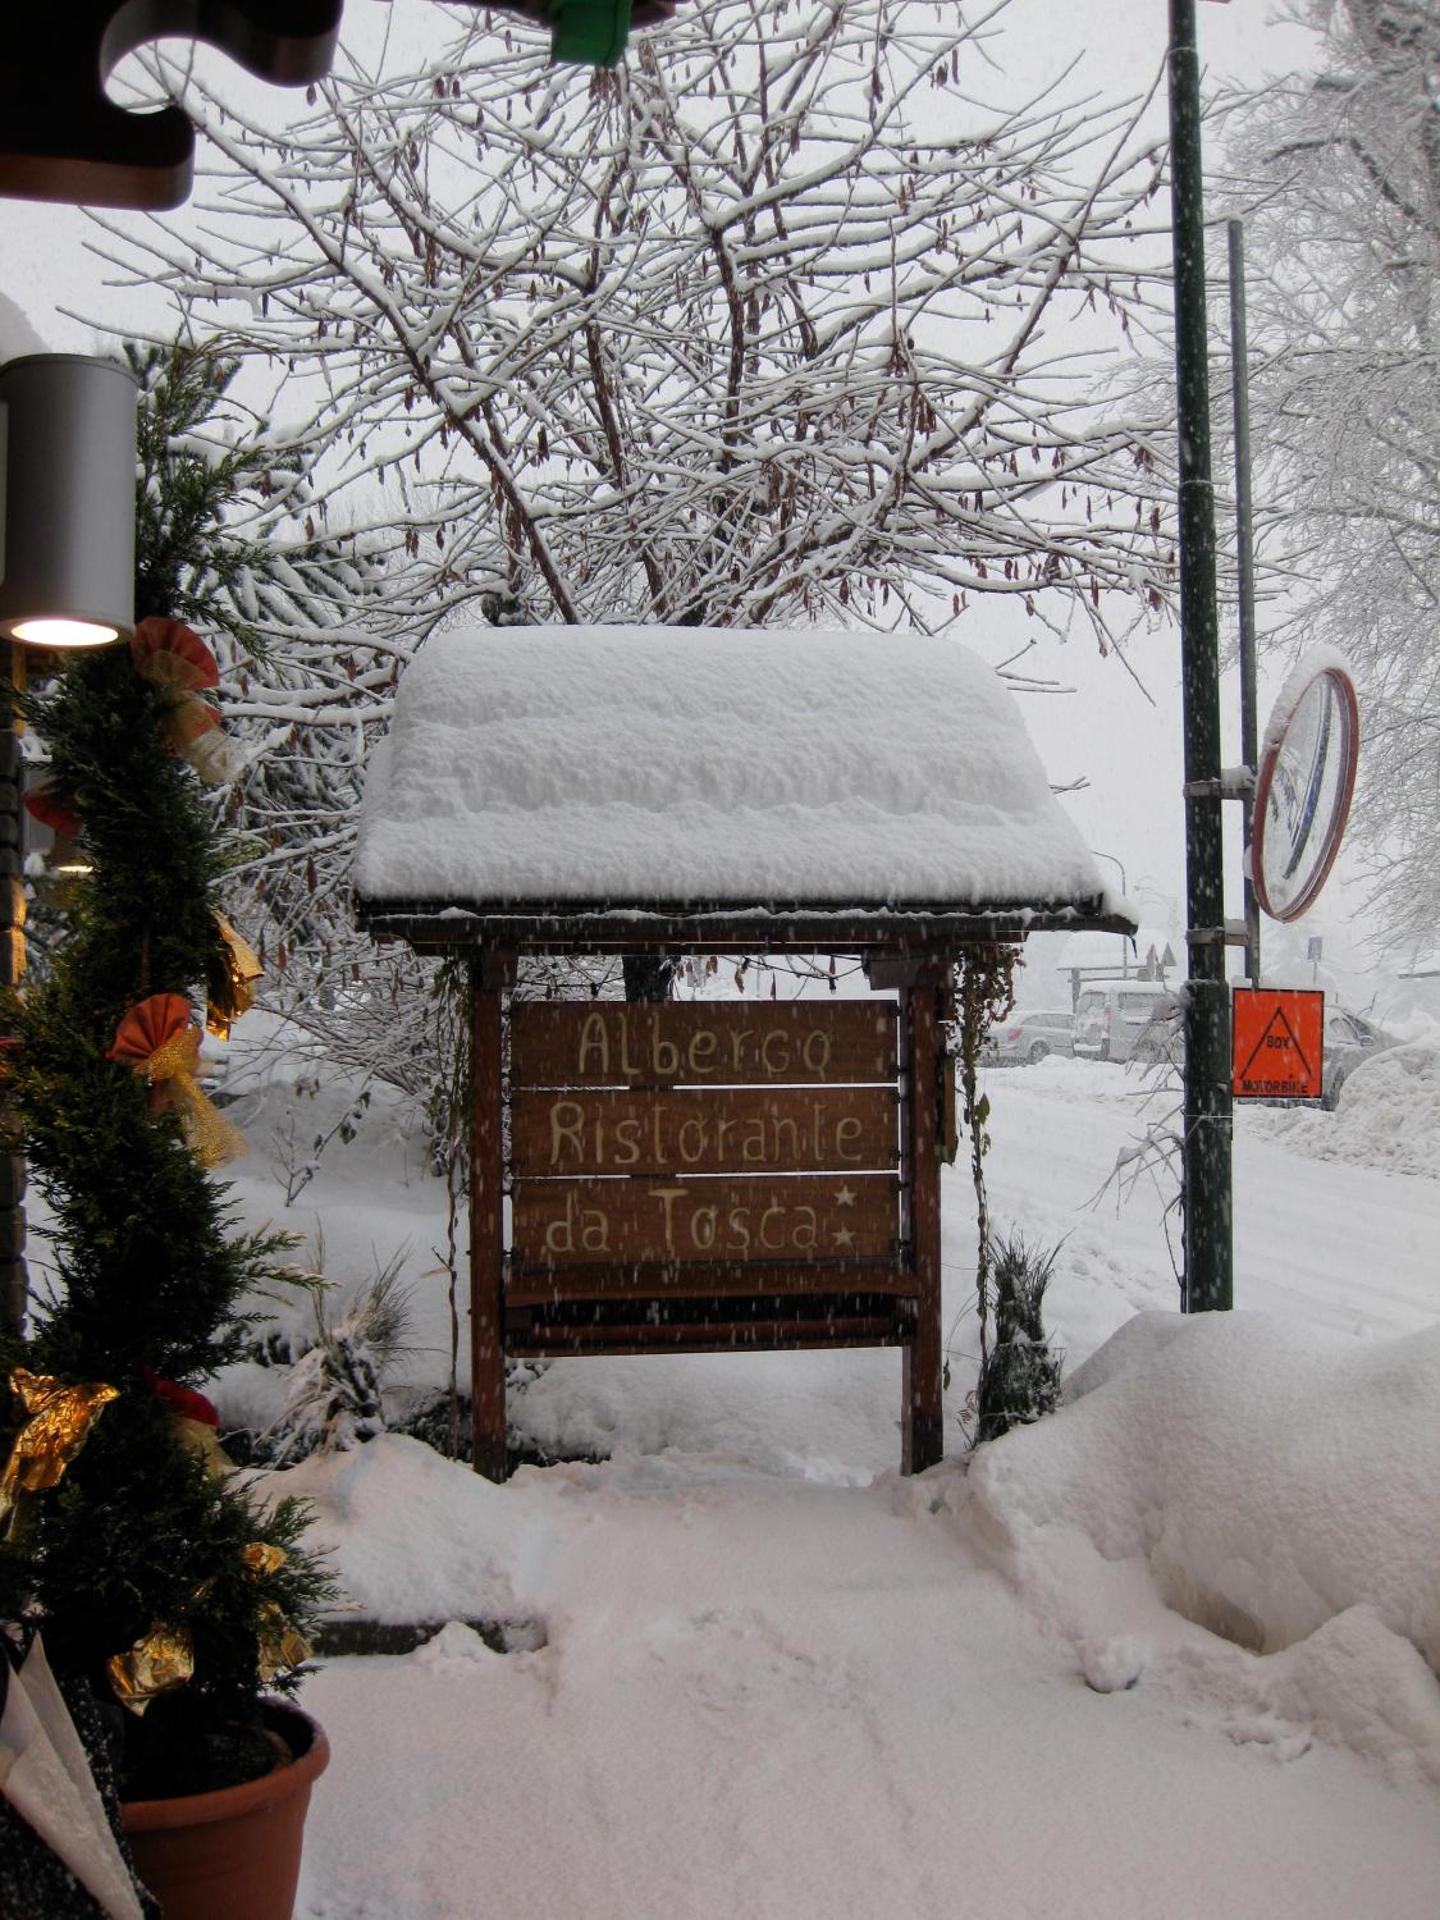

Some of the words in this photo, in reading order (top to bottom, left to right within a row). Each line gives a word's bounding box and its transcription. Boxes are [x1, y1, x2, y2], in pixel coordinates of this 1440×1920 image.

[578, 1012, 831, 1077] Albergo
[1266, 1036, 1290, 1049] BOX
[549, 1102, 863, 1165] Ristorante
[545, 1190, 611, 1253] da
[648, 1187, 818, 1252] Tosca
